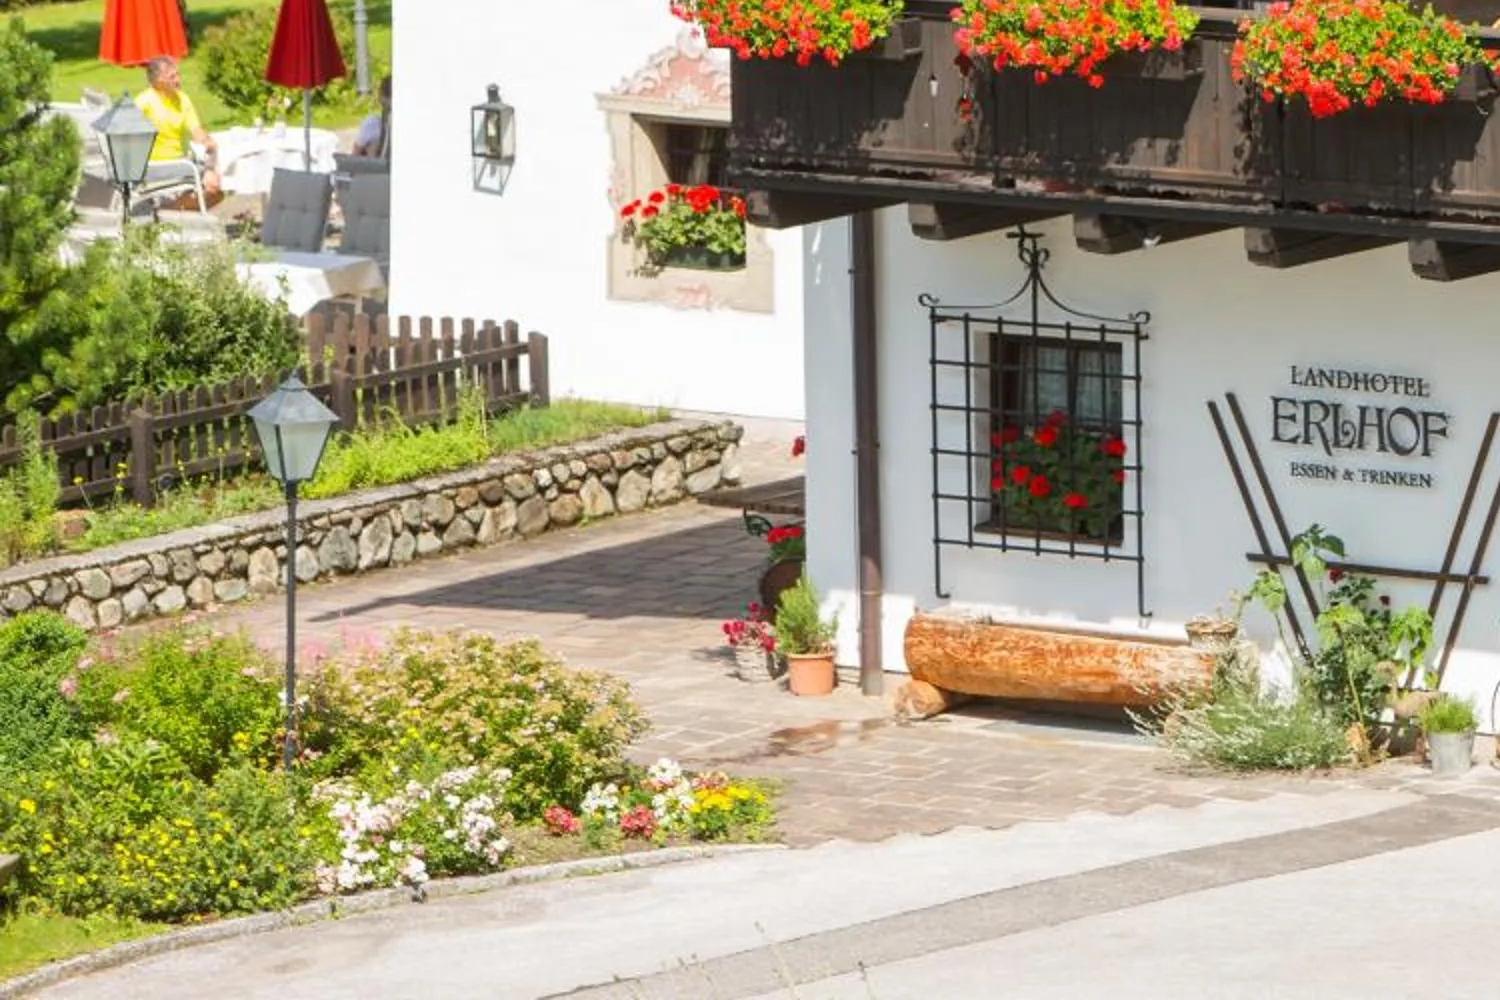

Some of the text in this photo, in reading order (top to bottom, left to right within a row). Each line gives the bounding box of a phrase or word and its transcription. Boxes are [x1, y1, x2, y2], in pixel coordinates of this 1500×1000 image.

[1290, 365, 1431, 397] LANDHOTEL
[1270, 396, 1452, 457] ERLHOF
[1290, 462, 1433, 488] ESSEN & TRINKEN
